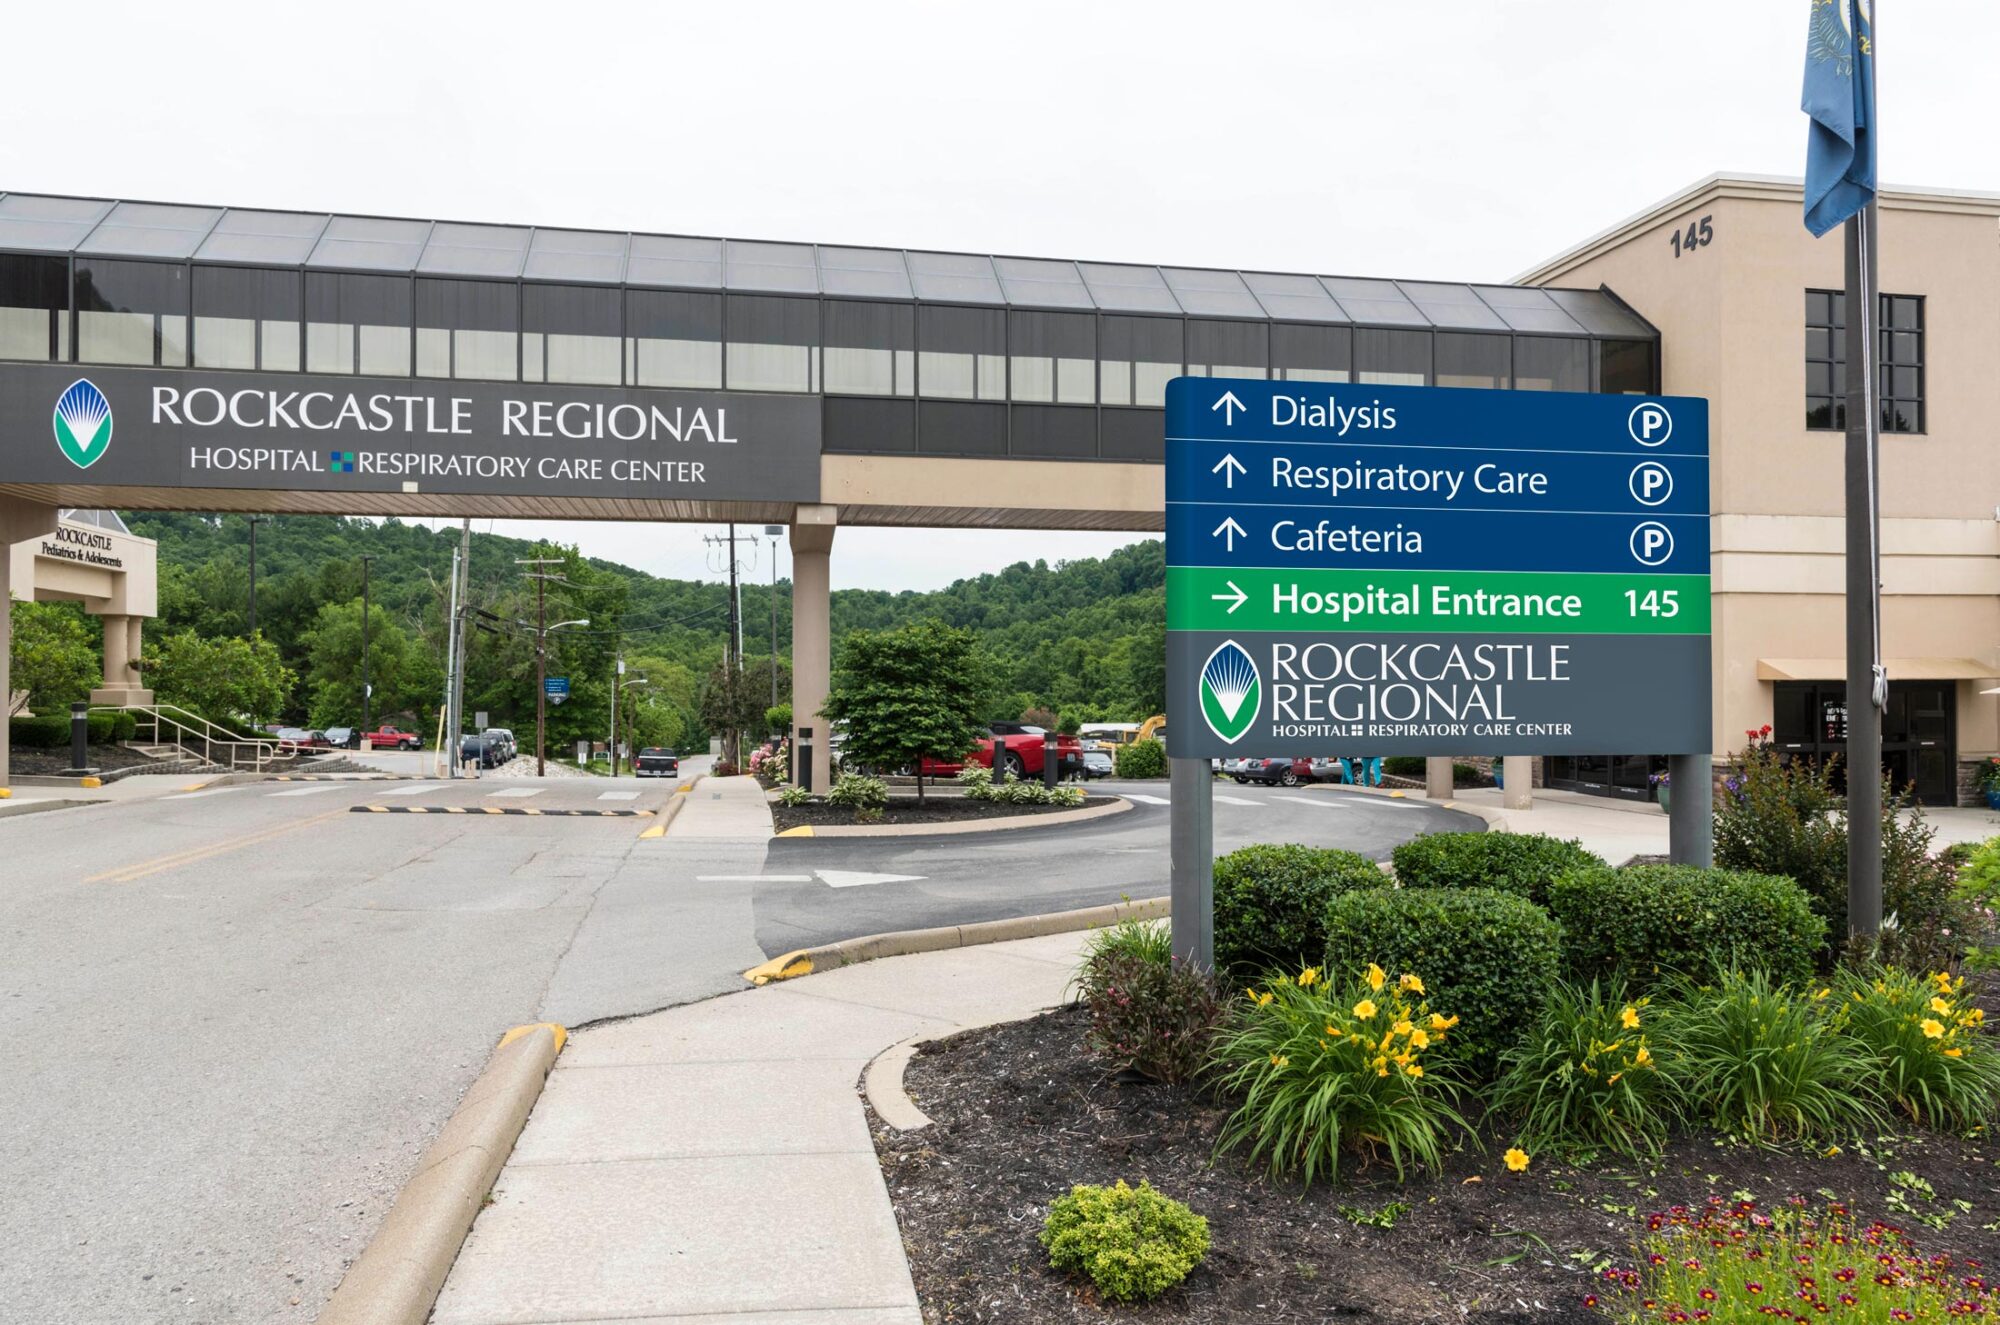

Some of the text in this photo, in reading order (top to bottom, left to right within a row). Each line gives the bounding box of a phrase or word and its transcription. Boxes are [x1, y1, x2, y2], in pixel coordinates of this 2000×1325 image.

[1670, 214, 1713, 258] 145
[152, 386, 738, 444] ROCKCASTLE REGIONAL
[1271, 395, 1397, 437] Dialysis
[190, 446, 706, 483] HOSPITAL RESPIRATORY CARE CENTER
[1272, 457, 1548, 501] Respiratory Care
[42, 541, 122, 568] Pediatrics & Adolescents
[56, 526, 112, 551] ROCKCASTLE
[1271, 520, 1422, 553] Cafeteria
[1272, 583, 1680, 622] Hospital Entrance 145
[1272, 642, 1571, 682] ROCKCASTLE
[1272, 683, 1516, 722] REGIONAL
[1272, 723, 1572, 737] HOSPITAL RESPIRATORY CARE CENTER
